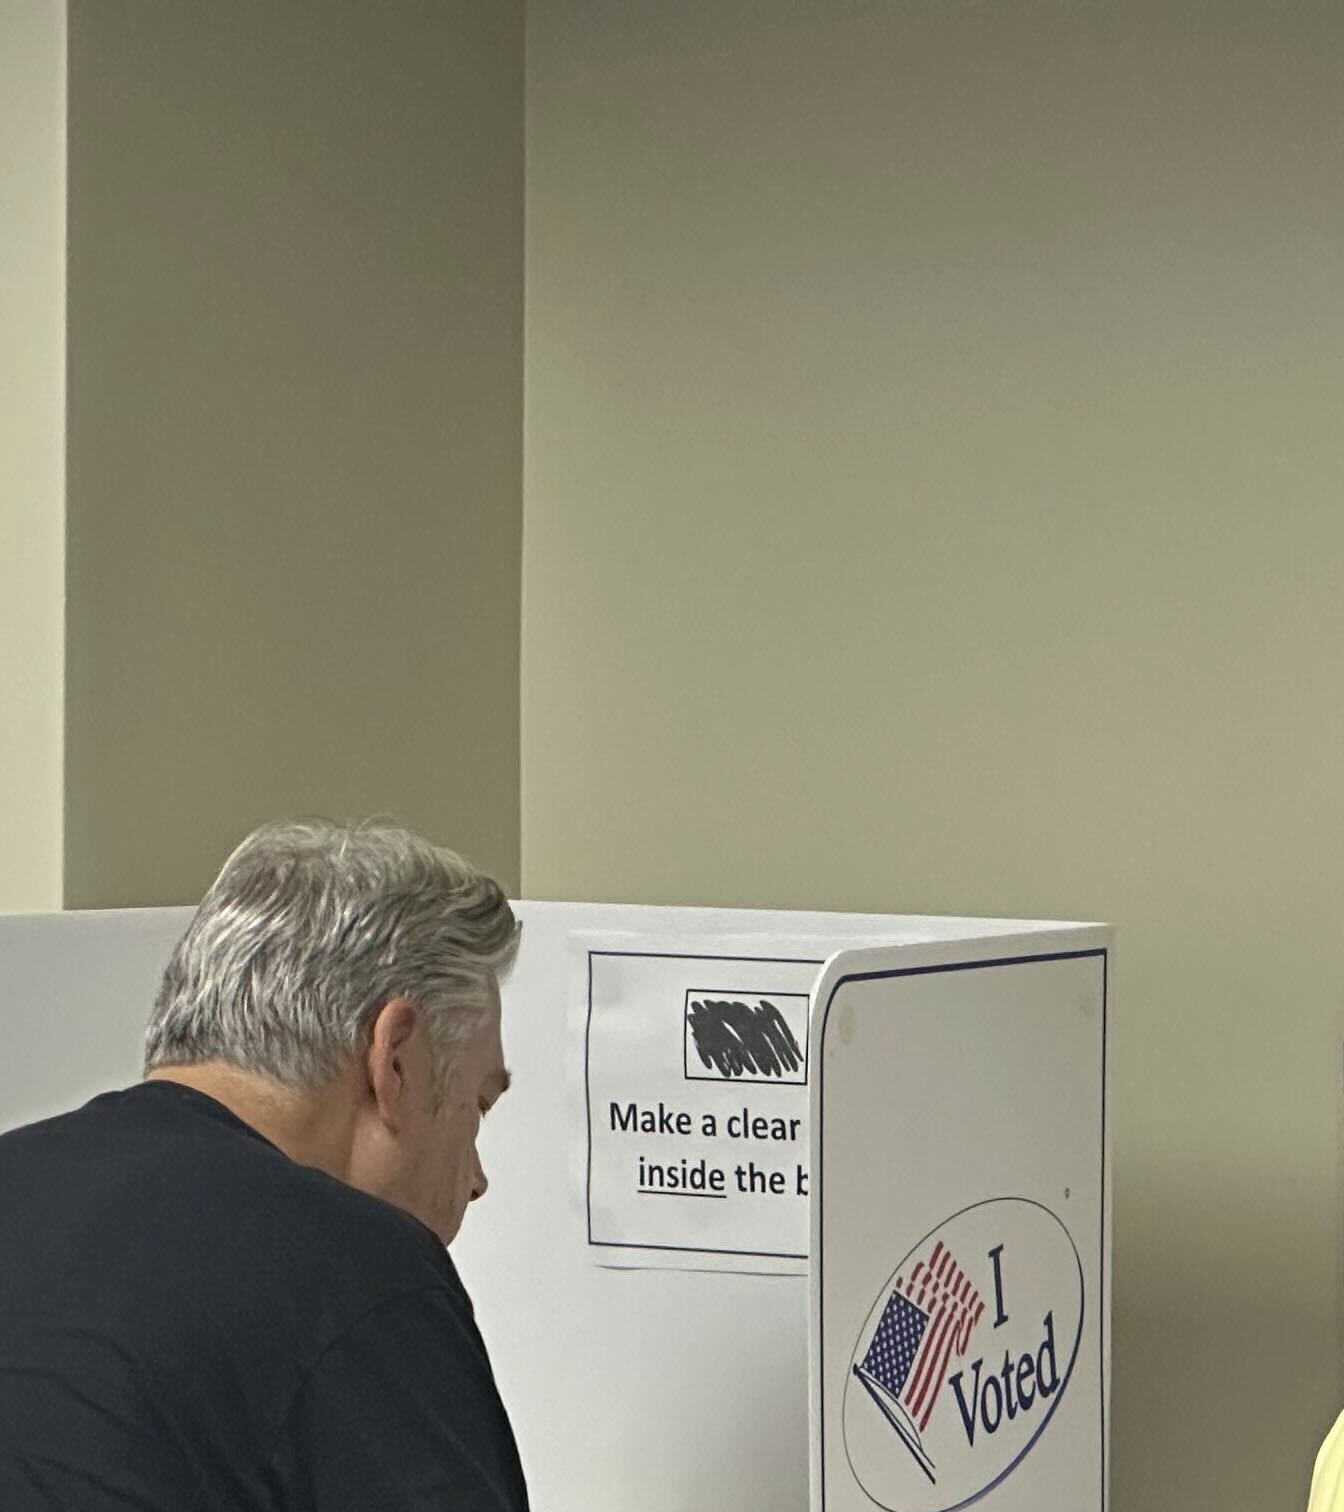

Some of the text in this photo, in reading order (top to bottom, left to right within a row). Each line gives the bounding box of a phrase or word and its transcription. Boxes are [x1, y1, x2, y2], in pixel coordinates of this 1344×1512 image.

[610, 1102, 801, 1141] Make a clear
[639, 1156, 725, 1190] inside
[734, 1161, 786, 1195] the
[988, 1243, 1009, 1329] I
[949, 1310, 1061, 1448] Voted
